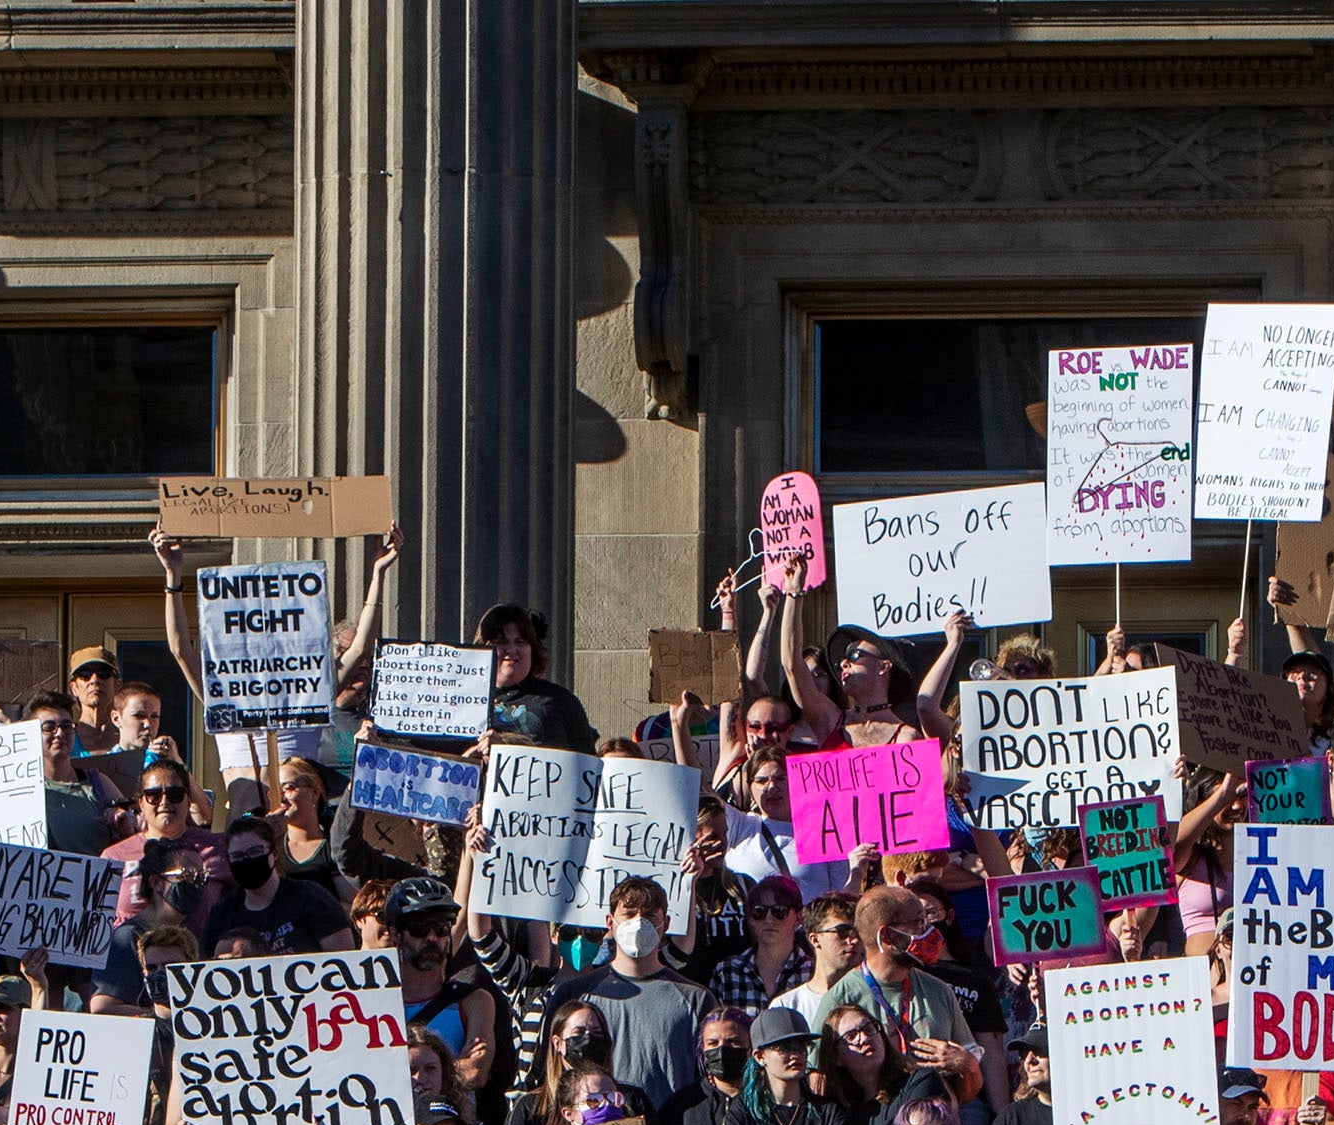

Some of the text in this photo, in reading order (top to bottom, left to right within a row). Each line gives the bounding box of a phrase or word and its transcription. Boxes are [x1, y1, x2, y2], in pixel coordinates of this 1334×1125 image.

[1263, 325, 1282, 343] NO
[1059, 352, 1103, 375] ROE
[1130, 347, 1189, 370] WADE
[1054, 372, 1170, 393] was NOT the
[1053, 398, 1189, 419] beginning women
[1108, 417, 1170, 432] abortions
[781, 478, 795, 490] I
[1134, 464, 1187, 479] women
[162, 483, 233, 498] Live,
[764, 492, 800, 509] AM A
[1077, 480, 1165, 513] DYING
[764, 505, 814, 525] WOMAN
[865, 501, 1013, 544] Bans off
[800, 525, 811, 539] A
[909, 540, 966, 577] our
[224, 608, 305, 634] FIGHT
[387, 645, 459, 657] Don't like
[206, 655, 324, 675] PATRIARCHY
[376, 661, 485, 676] abortions? Just
[230, 677, 321, 696] BIGOTRY
[378, 674, 462, 687] ignore them.
[378, 691, 408, 701] Like
[443, 696, 487, 705] ignore
[977, 683, 1169, 730] DON'T LIKE
[372, 706, 451, 719] children in
[397, 721, 482, 734] foster care.
[978, 723, 1170, 772] ABORTION?
[358, 745, 478, 788] ABORTION
[891, 750, 921, 786] IS
[493, 757, 646, 812] KEEP SAFE
[1250, 769, 1288, 790] NOT
[1252, 790, 1305, 813] YOUR
[854, 792, 917, 848] LIE
[1098, 803, 1143, 828] NOT
[1246, 828, 1278, 865] I
[998, 880, 1078, 918] FUCK
[1242, 867, 1324, 906] AM
[1012, 918, 1072, 952] YOU
[1064, 971, 1171, 997] AGAINST
[1241, 957, 1271, 986] of
[175, 994, 304, 1041] only
[34, 1028, 84, 1064] PRO
[1085, 1037, 1175, 1059] HAVE A
[180, 1036, 312, 1086] safe
[45, 1067, 99, 1103] LIFE
